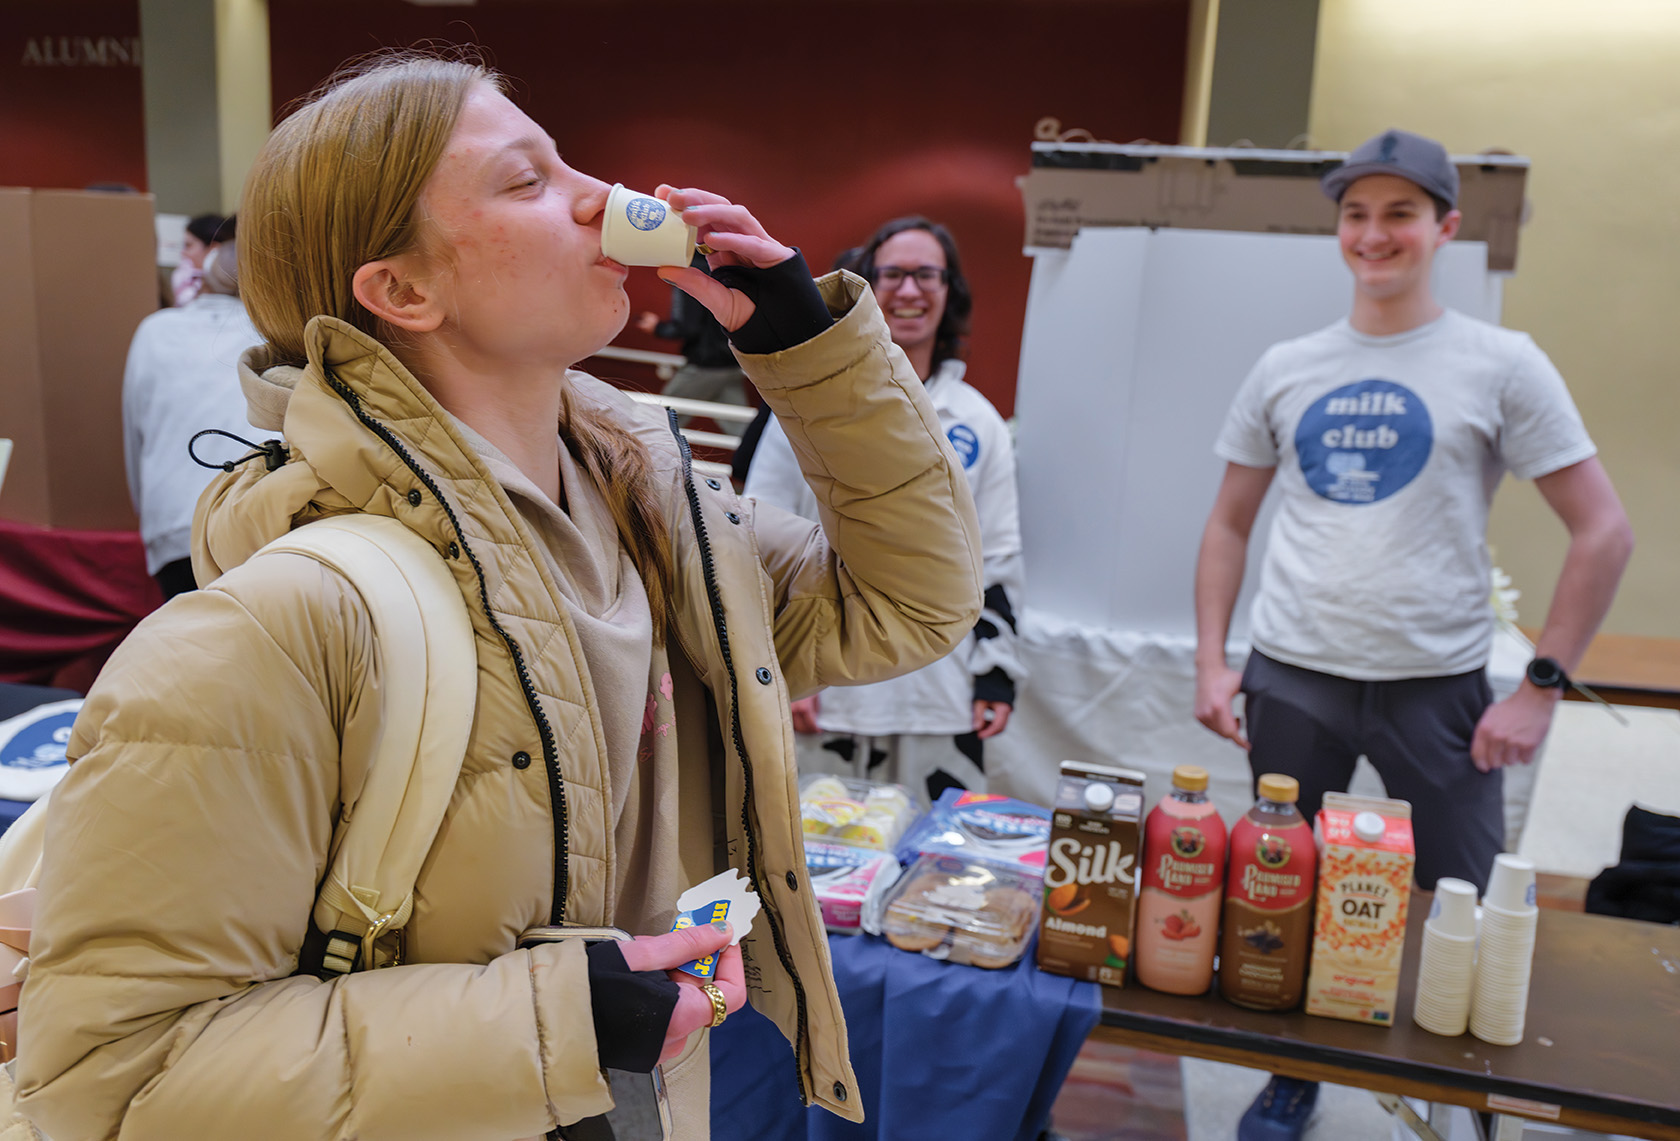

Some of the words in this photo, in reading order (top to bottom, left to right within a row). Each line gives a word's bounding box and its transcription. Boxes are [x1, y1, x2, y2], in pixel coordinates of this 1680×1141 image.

[22, 35, 141, 67] ALUMNI
[1324, 391, 1407, 416] milk
[1321, 424, 1399, 450] club
[1044, 837, 1135, 888] Silk
[1341, 881, 1389, 899] PLANET
[1342, 899, 1385, 919] OAT
[1045, 916, 1107, 939] Almond
